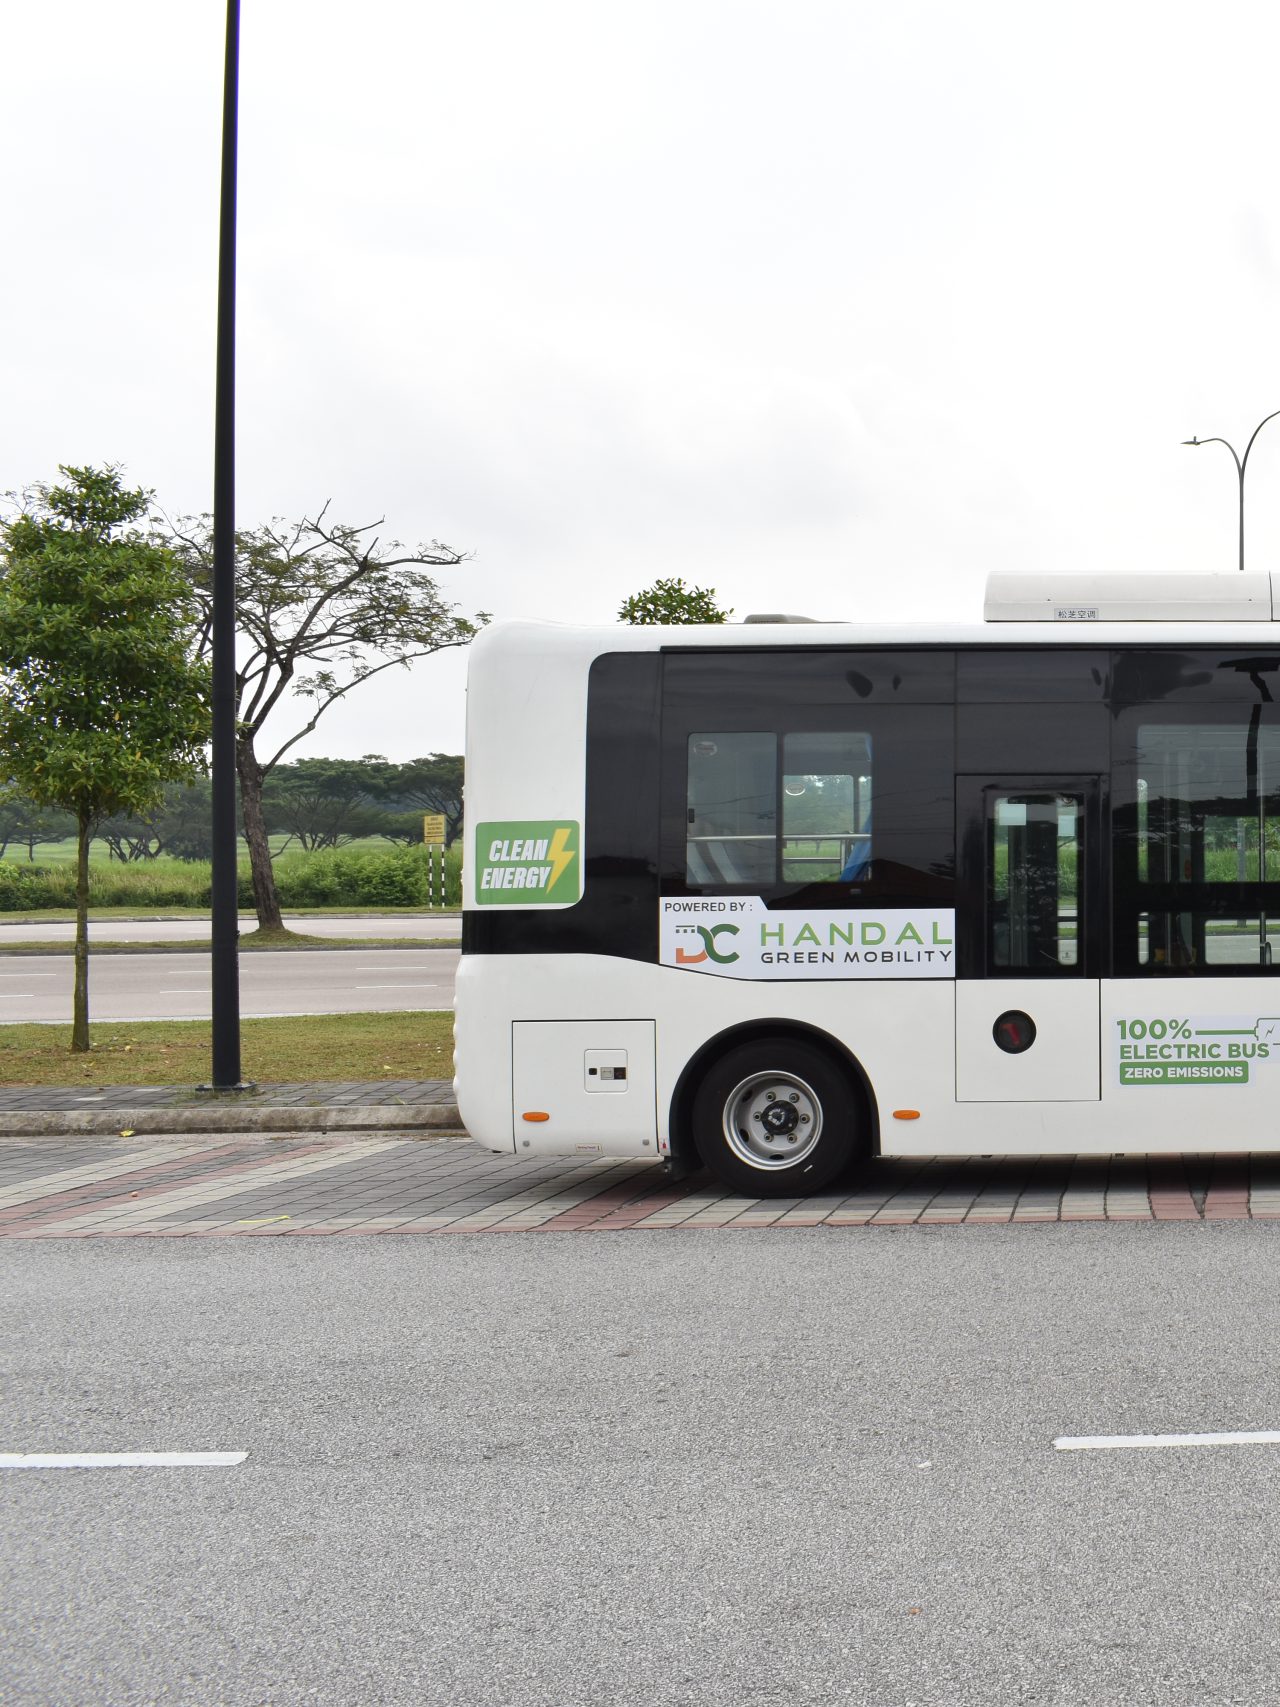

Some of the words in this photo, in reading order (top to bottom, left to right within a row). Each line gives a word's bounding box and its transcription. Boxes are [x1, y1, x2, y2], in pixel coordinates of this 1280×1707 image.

[489, 839, 548, 862] CLEAN
[480, 866, 552, 889] ENERGY
[664, 902, 726, 912] POWERED
[760, 921, 953, 946] HANDAL
[761, 951, 834, 964] GREEN
[844, 950, 952, 963] MOBILITY
[1117, 1019, 1192, 1040] 100%
[1120, 1043, 1221, 1060] ELECTRIC
[1228, 1042, 1270, 1059] BUS
[1124, 1067, 1164, 1079] ZERO
[1167, 1066, 1244, 1078] EMISSIONS
